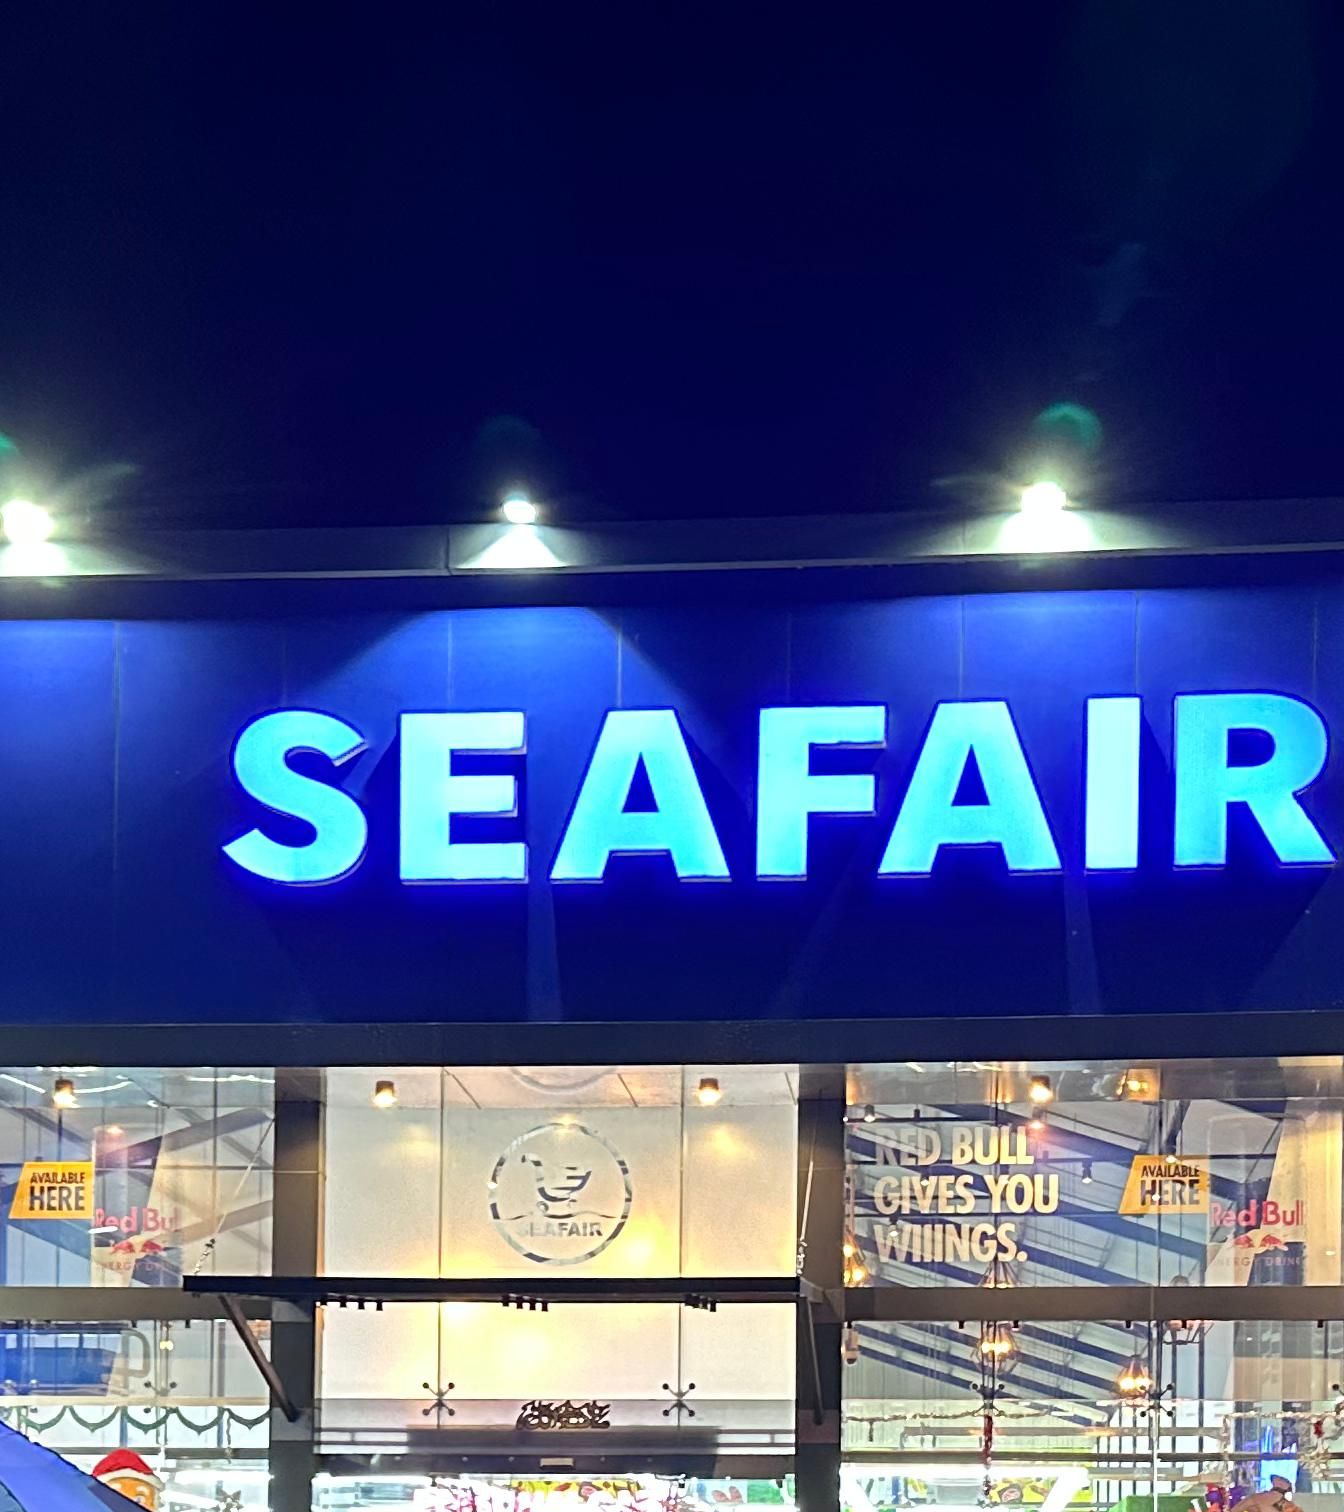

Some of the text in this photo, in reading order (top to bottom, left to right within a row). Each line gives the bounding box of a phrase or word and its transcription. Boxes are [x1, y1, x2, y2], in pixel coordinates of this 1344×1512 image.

[221, 689, 1338, 885] SEAFAIR
[875, 1126, 1035, 1166] RED BULL
[30, 1172, 86, 1184] AVAILABLE
[1141, 1164, 1200, 1178] AVAILABLE
[29, 1186, 86, 1211] HERE
[874, 1174, 1059, 1214] GIVES YOU
[1140, 1179, 1201, 1206] HERE
[94, 1206, 138, 1233] Red
[1211, 1199, 1304, 1226] Red Bull
[874, 1223, 1029, 1263] WIIINGS.
